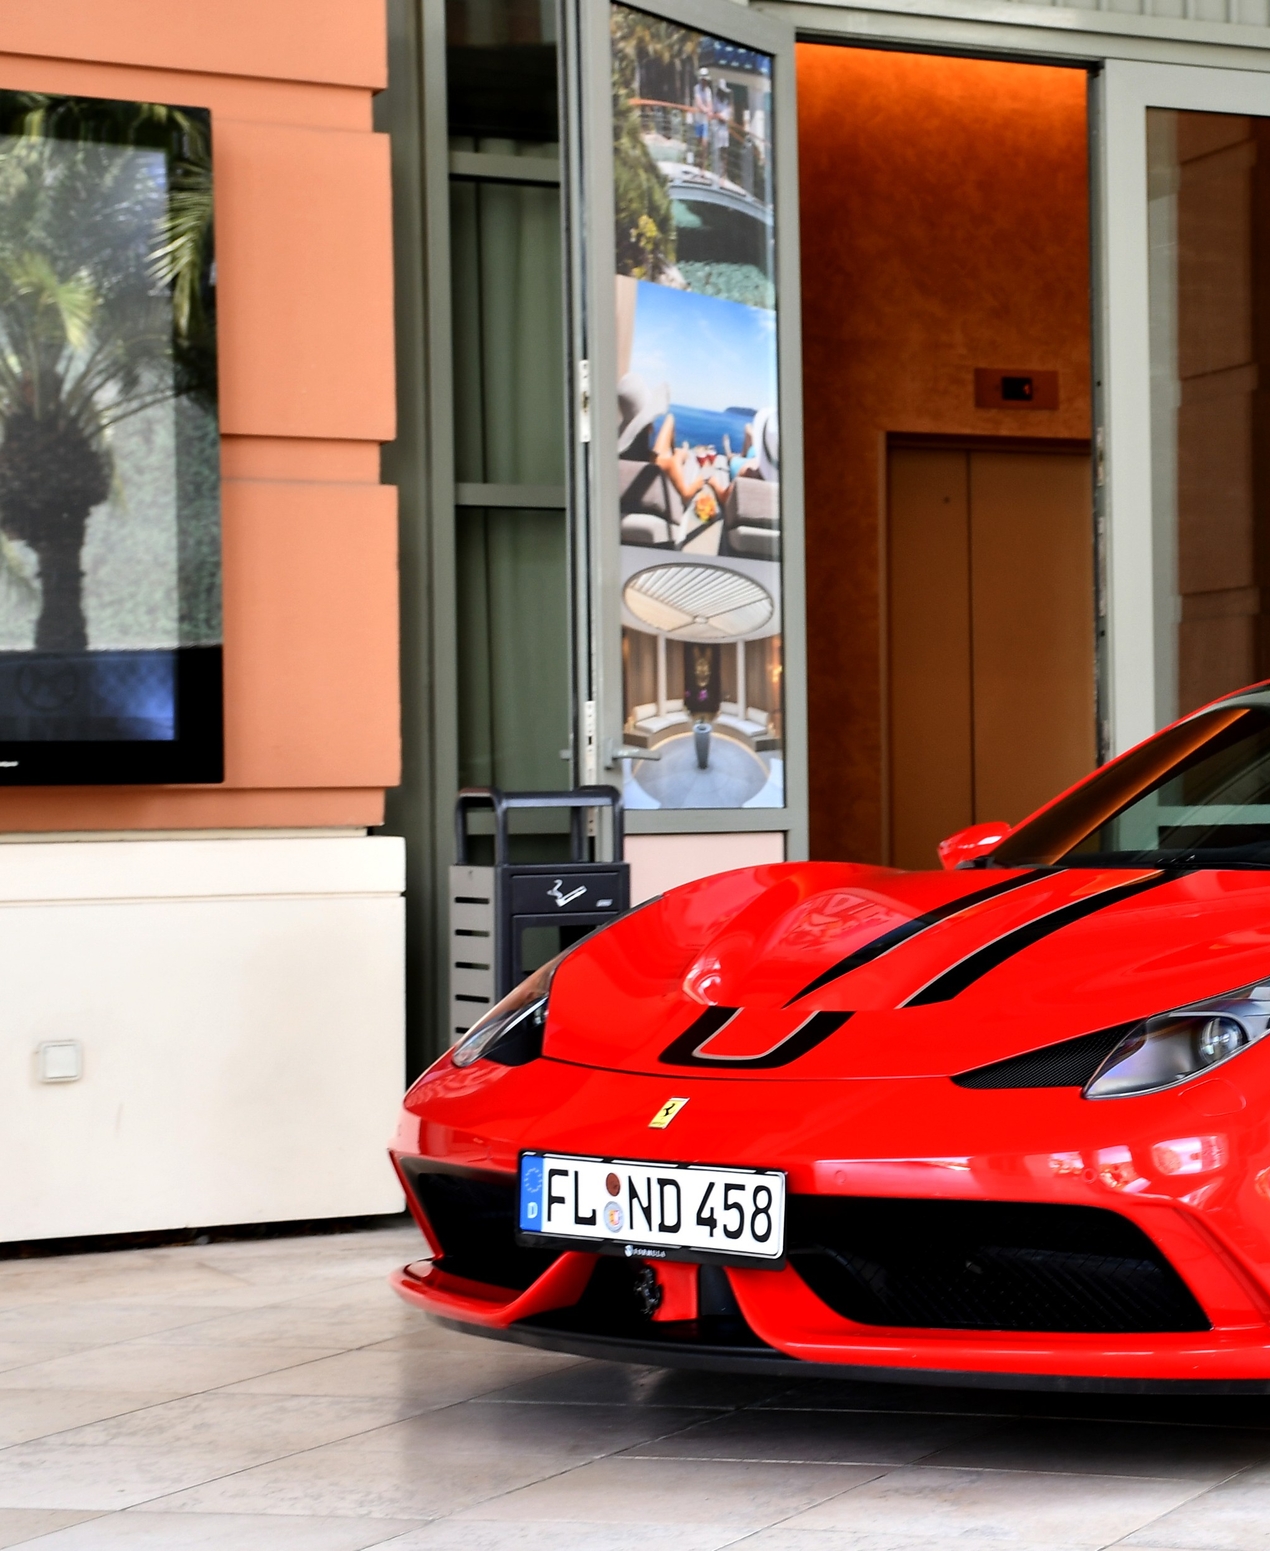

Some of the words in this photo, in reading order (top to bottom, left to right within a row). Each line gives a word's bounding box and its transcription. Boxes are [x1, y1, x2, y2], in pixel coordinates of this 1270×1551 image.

[527, 1202, 538, 1219] D
[547, 1168, 597, 1226] FL
[628, 1175, 682, 1234] ND
[696, 1181, 773, 1244] 458
